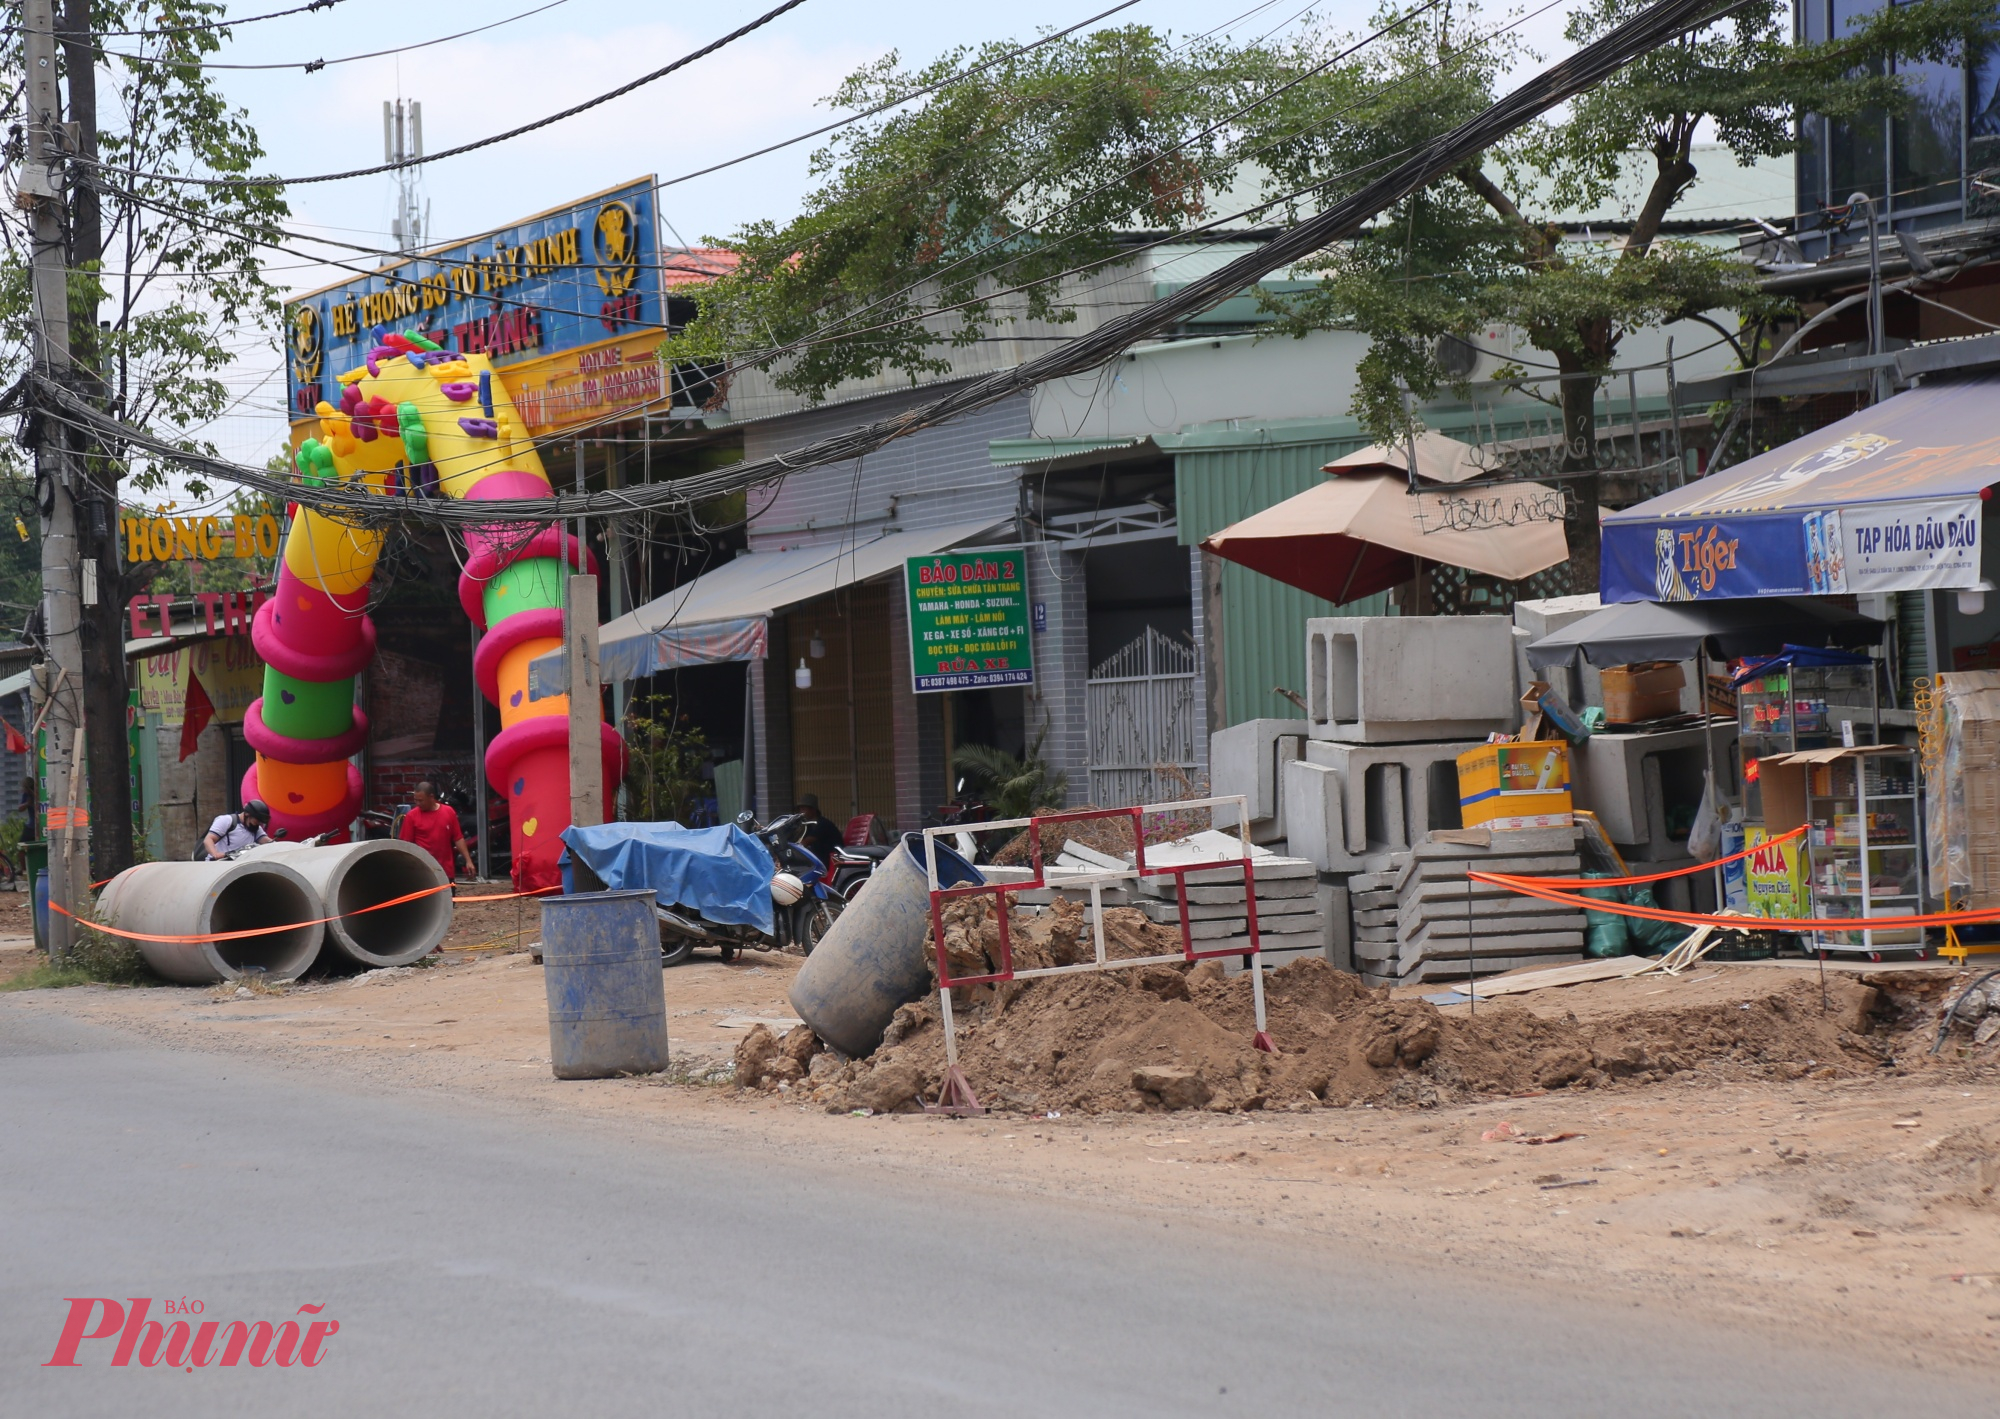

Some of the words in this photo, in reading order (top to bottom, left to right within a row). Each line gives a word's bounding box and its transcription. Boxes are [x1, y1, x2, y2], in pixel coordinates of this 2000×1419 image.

[523, 228, 579, 278] NINH
[601, 294, 639, 332] QTV
[120, 500, 223, 562] HỐNG
[1856, 527, 1881, 563] TẠP
[1885, 519, 1911, 553] HÓA
[919, 559, 957, 584] BẢO
[961, 558, 999, 582] DÂN
[1003, 561, 1015, 579] 2
[1678, 525, 1739, 592] Tiger
[998, 581, 1021, 592] TRANG
[918, 601, 950, 612] YAMAHA
[955, 599, 980, 610] HONDA
[923, 631, 933, 640] XE
[934, 630, 945, 640] GA
[950, 629, 960, 639] XE
[938, 656, 980, 672] RỬA
[983, 657, 1009, 670] XE
